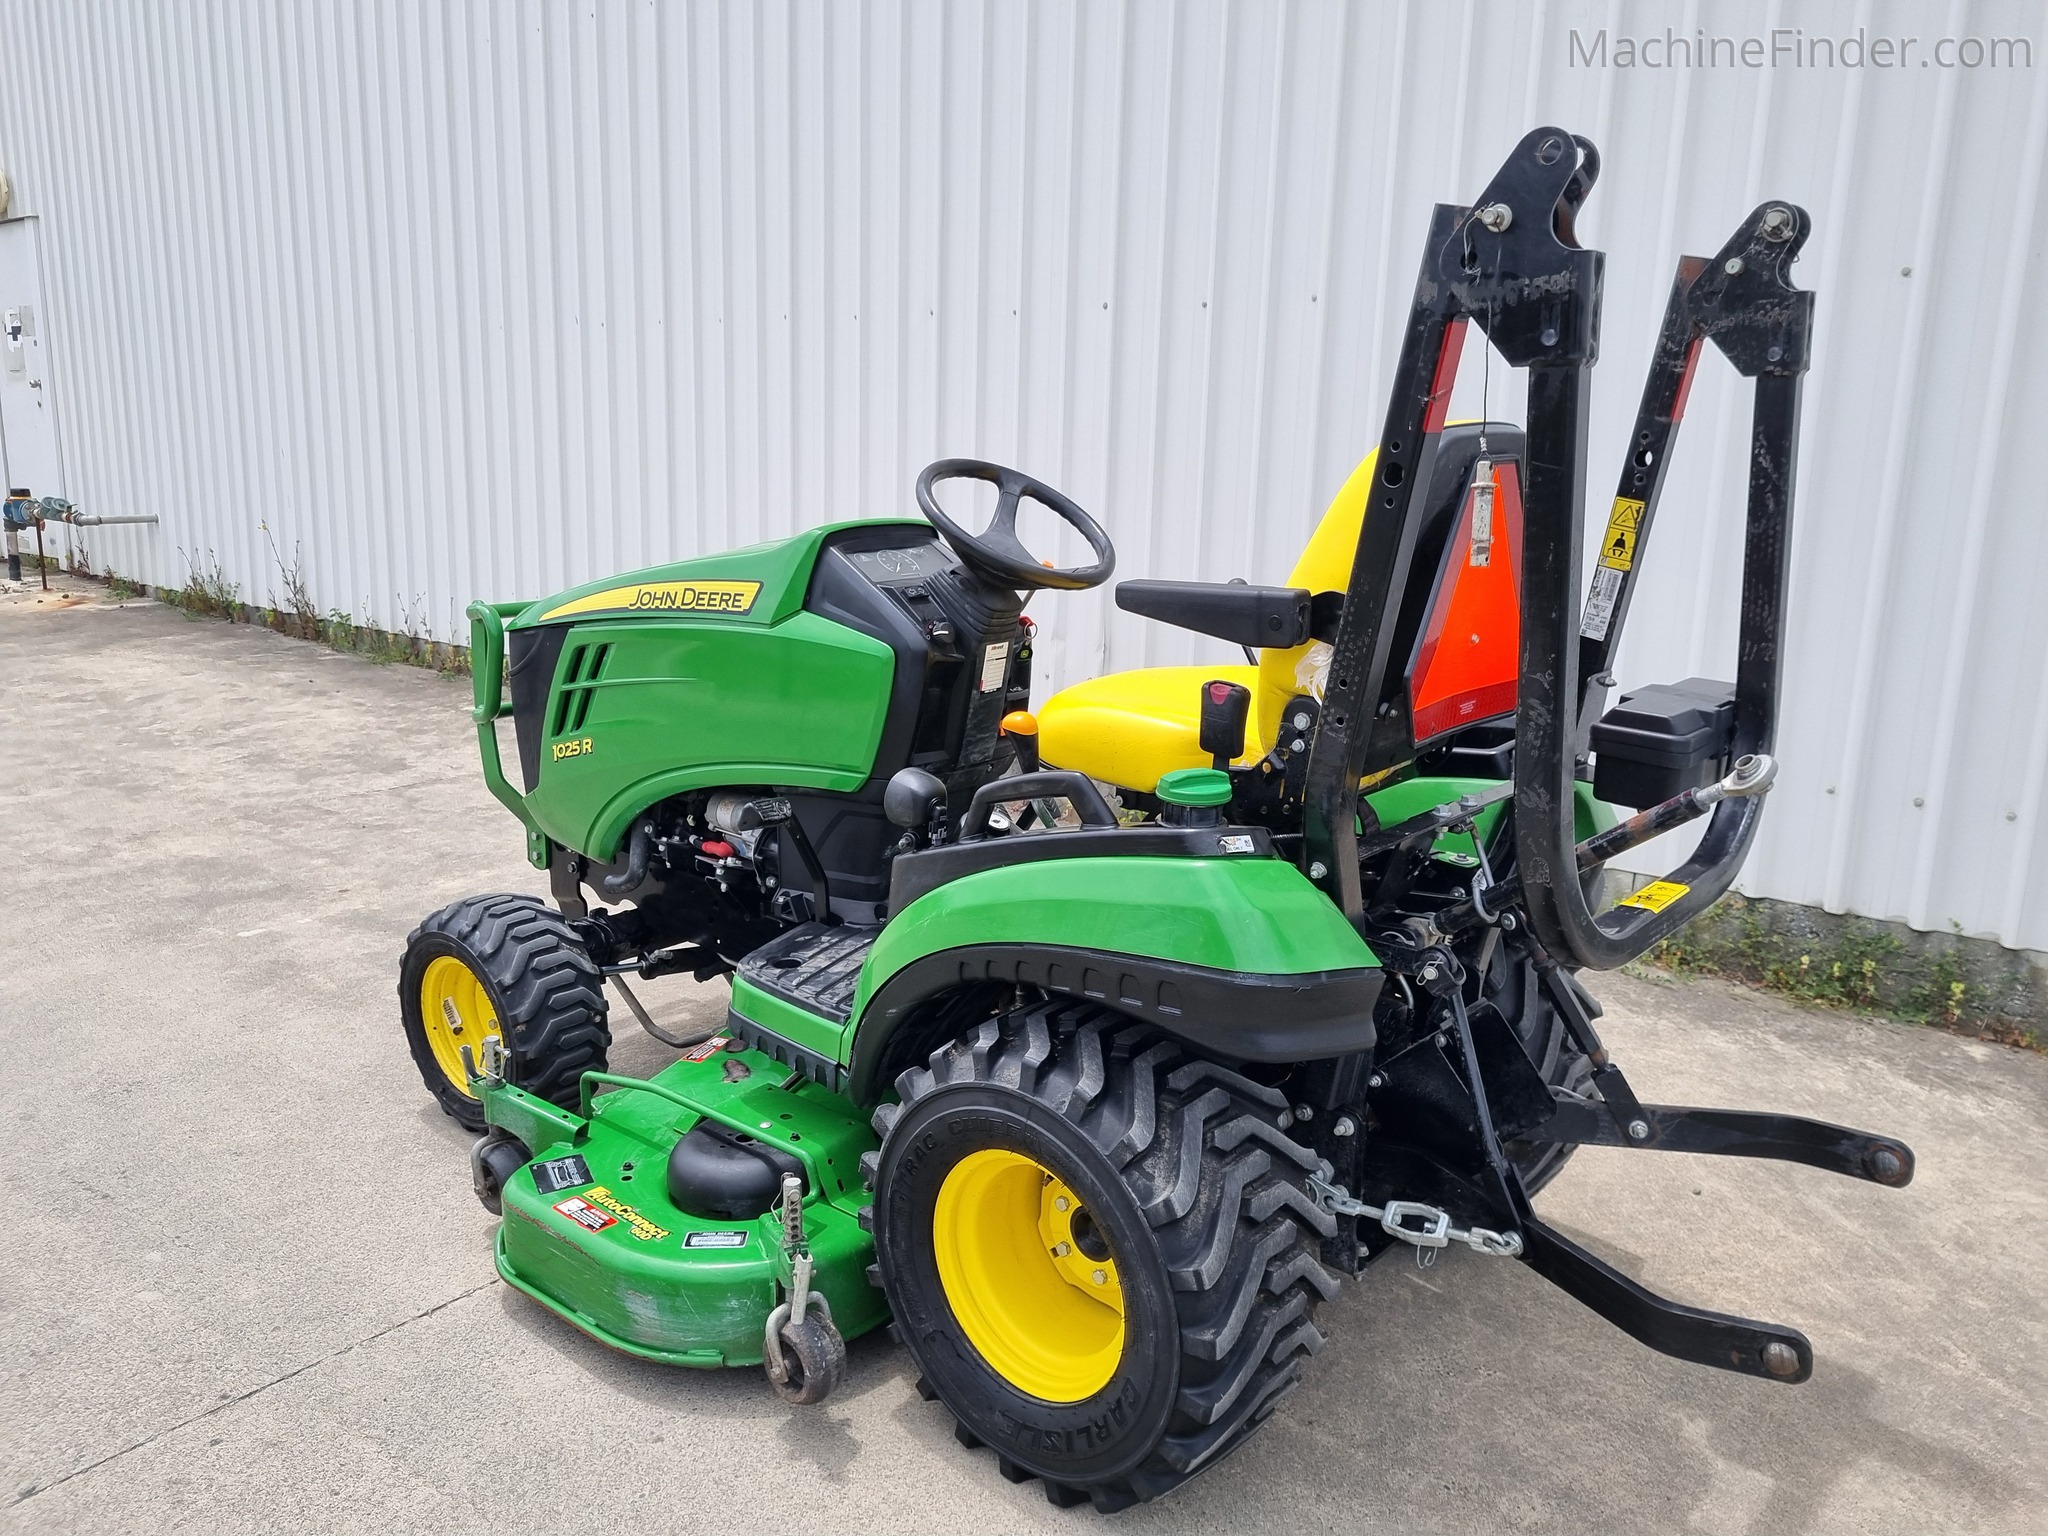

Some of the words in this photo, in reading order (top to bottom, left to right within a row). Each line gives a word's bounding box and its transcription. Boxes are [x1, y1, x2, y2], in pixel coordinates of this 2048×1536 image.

[628, 588, 678, 607] JOHN
[680, 587, 745, 609] DEERE
[552, 740, 581, 762] 1025
[582, 738, 593, 754] R
[898, 1131, 938, 1182] TRAC
[948, 1116, 1021, 1138] CHIEF
[585, 1188, 671, 1240] AutoConnect
[630, 1226, 654, 1241] 60D
[996, 1376, 1141, 1453] CARLISLE
